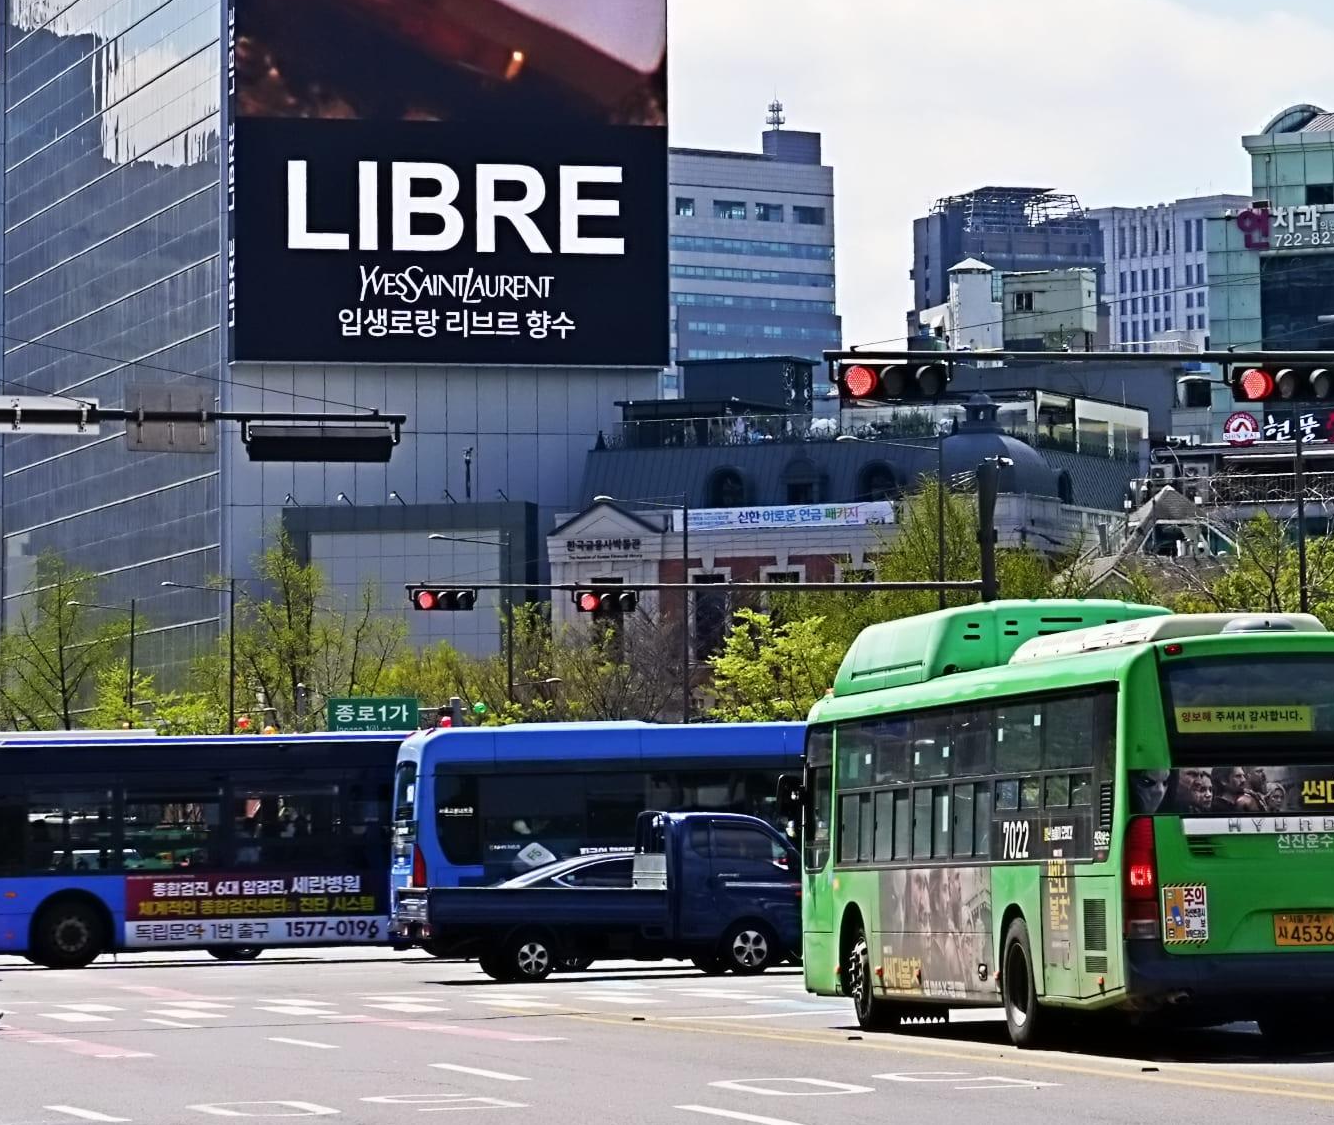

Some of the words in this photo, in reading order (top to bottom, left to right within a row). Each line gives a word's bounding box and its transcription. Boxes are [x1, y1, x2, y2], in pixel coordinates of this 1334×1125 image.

[228, 7, 236, 95] LIBRE
[228, 123, 236, 211] LIBRE
[285, 160, 625, 255] LIBRE
[228, 238, 236, 328] LIBRE
[338, 308, 440, 338] 입생로랑
[445, 309, 520, 338] 리브르
[525, 310, 576, 339] 향수
[737, 510, 760, 524] 신한
[799, 508, 822, 521] 연금
[825, 506, 859, 521] 패키지
[334, 704, 409, 722] 종로1가
[1181, 711, 1212, 722] 양보해
[1215, 711, 1246, 722] 주셔서
[1249, 710, 1303, 722] 감사합니다.
[1002, 820, 1029, 859] 7022
[1277, 833, 1334, 849] 선진운수
[152, 882, 212, 899] 종합검진,
[215, 880, 240, 896] 6대
[291, 875, 361, 893] 세란병원
[1184, 887, 1205, 907] 주의
[138, 899, 197, 916] 체계적인
[299, 896, 329, 912] 진단
[332, 896, 375, 911] 시스템
[135, 922, 204, 942] 독립문역
[209, 923, 234, 940] 1번
[237, 922, 270, 939] 출구
[285, 920, 380, 938] 1577-0196
